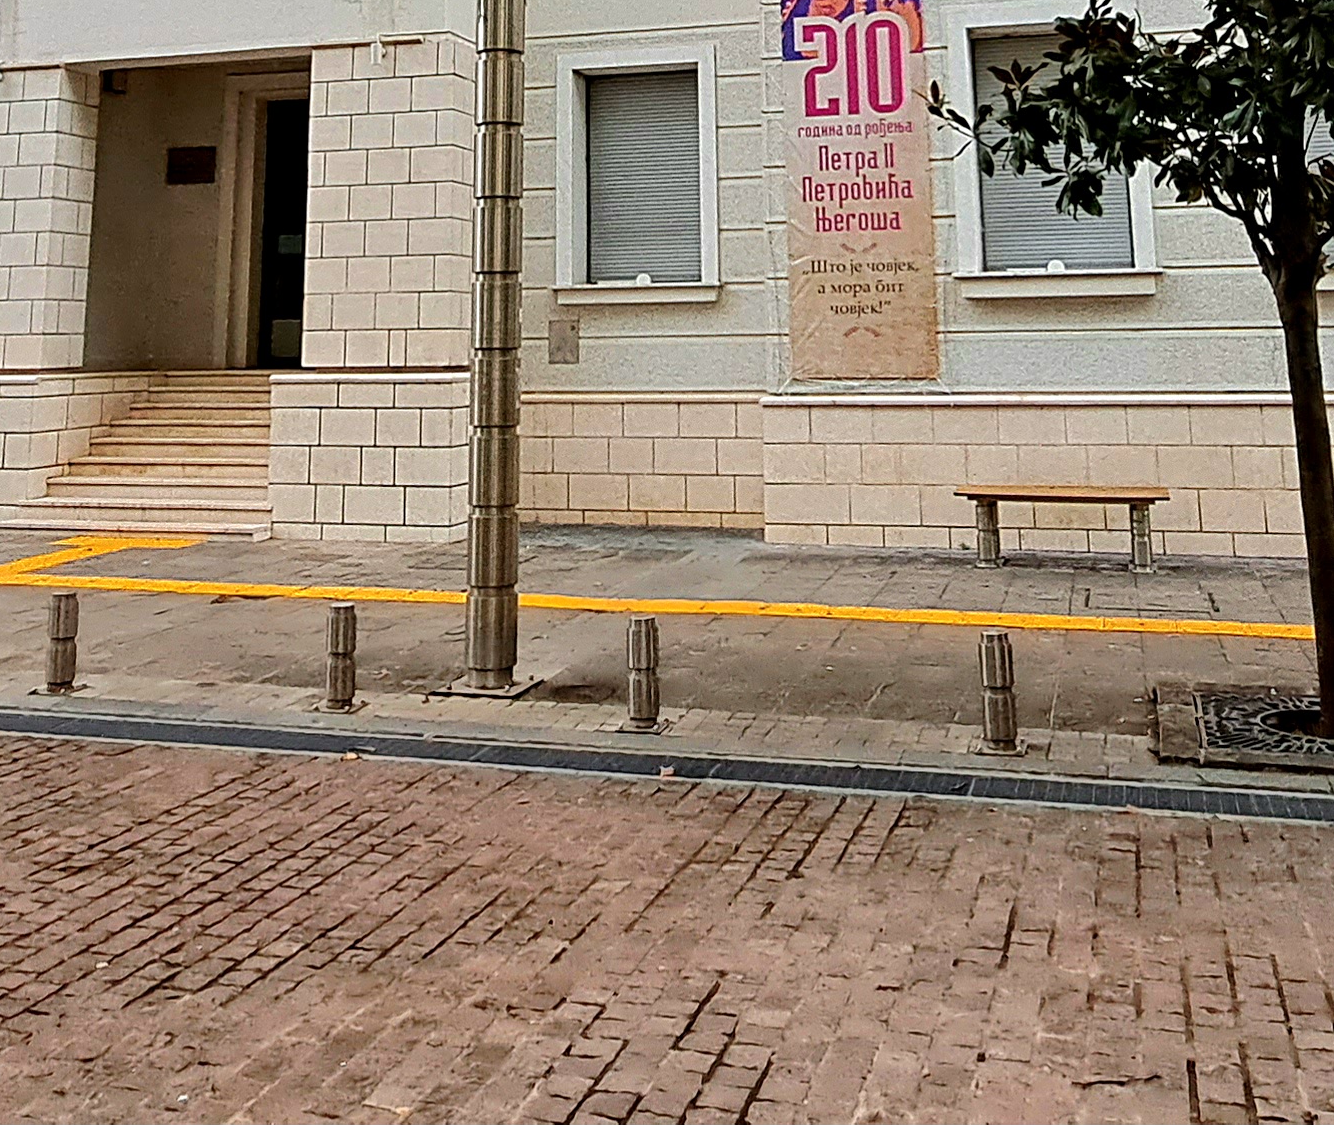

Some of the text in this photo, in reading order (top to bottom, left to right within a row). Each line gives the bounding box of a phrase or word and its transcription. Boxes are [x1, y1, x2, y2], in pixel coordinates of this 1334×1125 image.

[802, 19, 904, 117] 210
[798, 119, 913, 139] година од рођења
[819, 146, 878, 176] Петра
[803, 173, 913, 208] Петровића
[815, 206, 901, 232] Његоша
[849, 259, 863, 278] је
[818, 280, 905, 298] а мора бит
